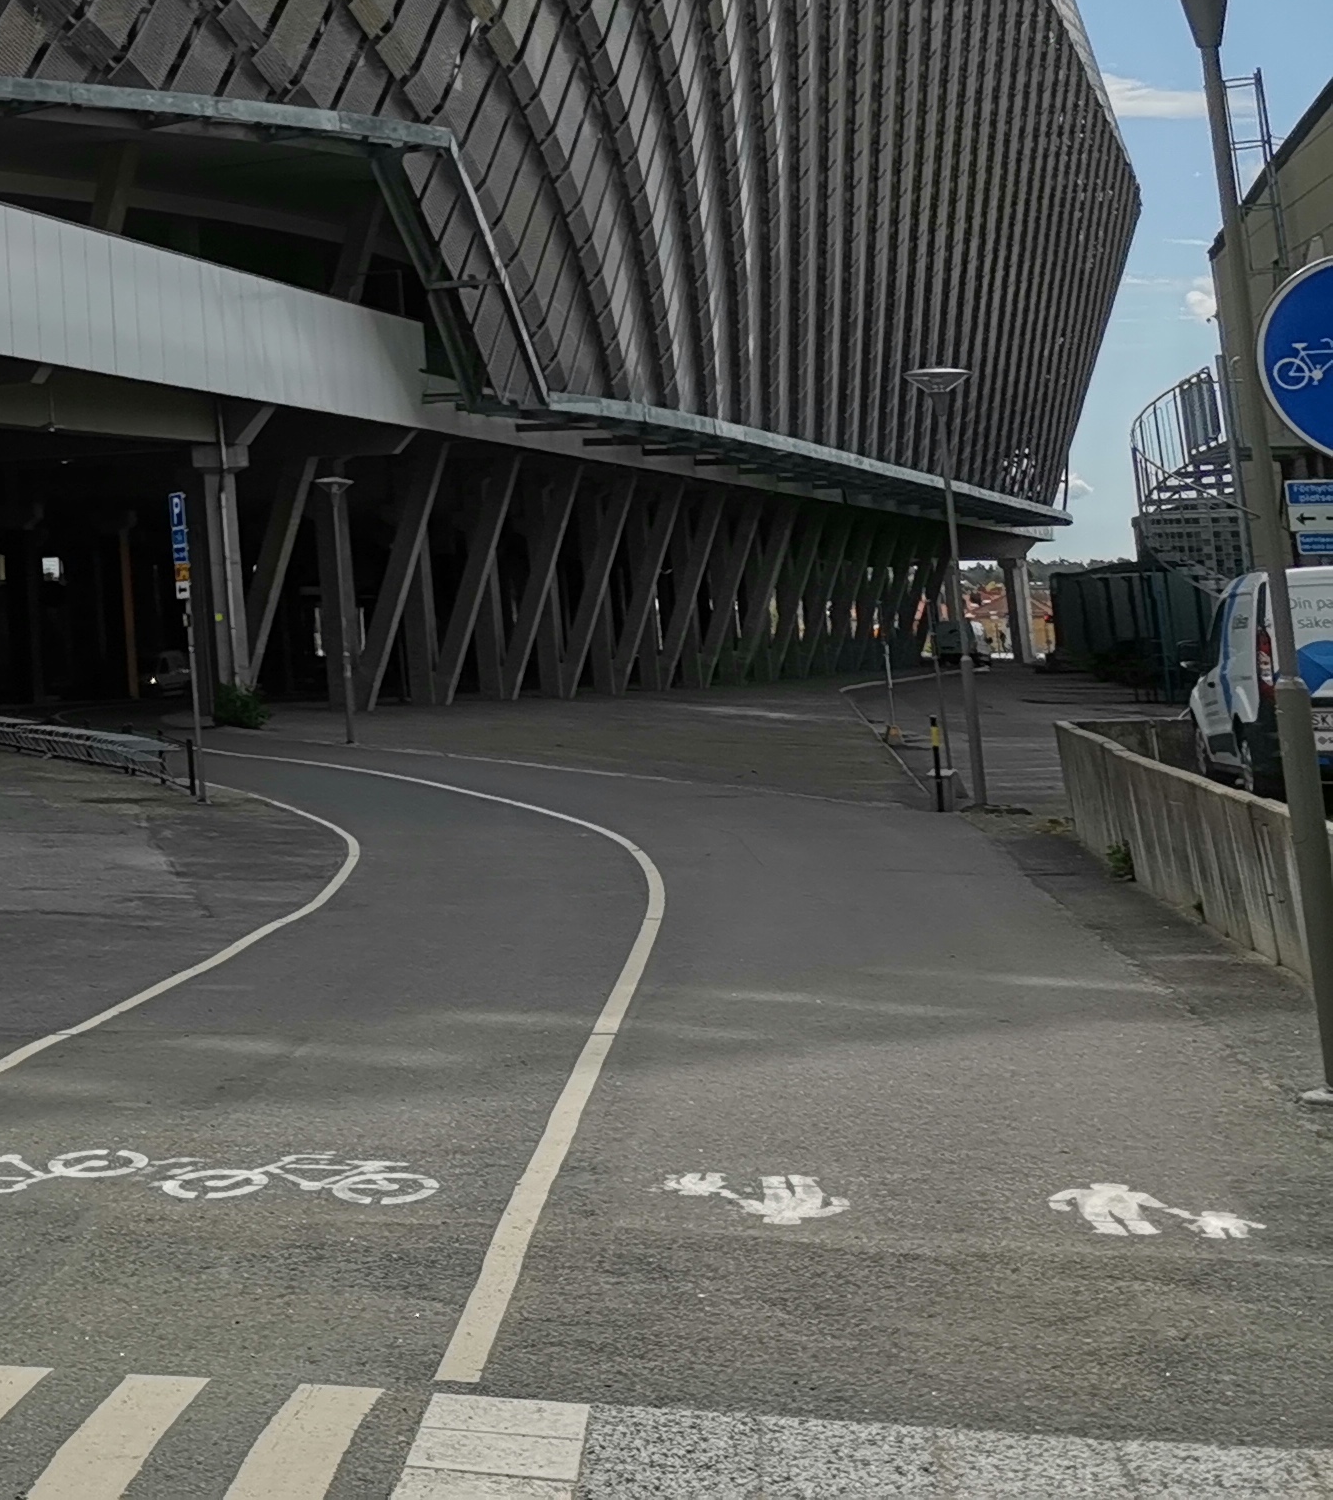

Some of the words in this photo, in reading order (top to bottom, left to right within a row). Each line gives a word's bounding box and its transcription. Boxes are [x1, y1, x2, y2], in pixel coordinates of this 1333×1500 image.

[172, 497, 181, 525] P
[1297, 615, 1333, 629] säke
[1312, 713, 1333, 726] SK
